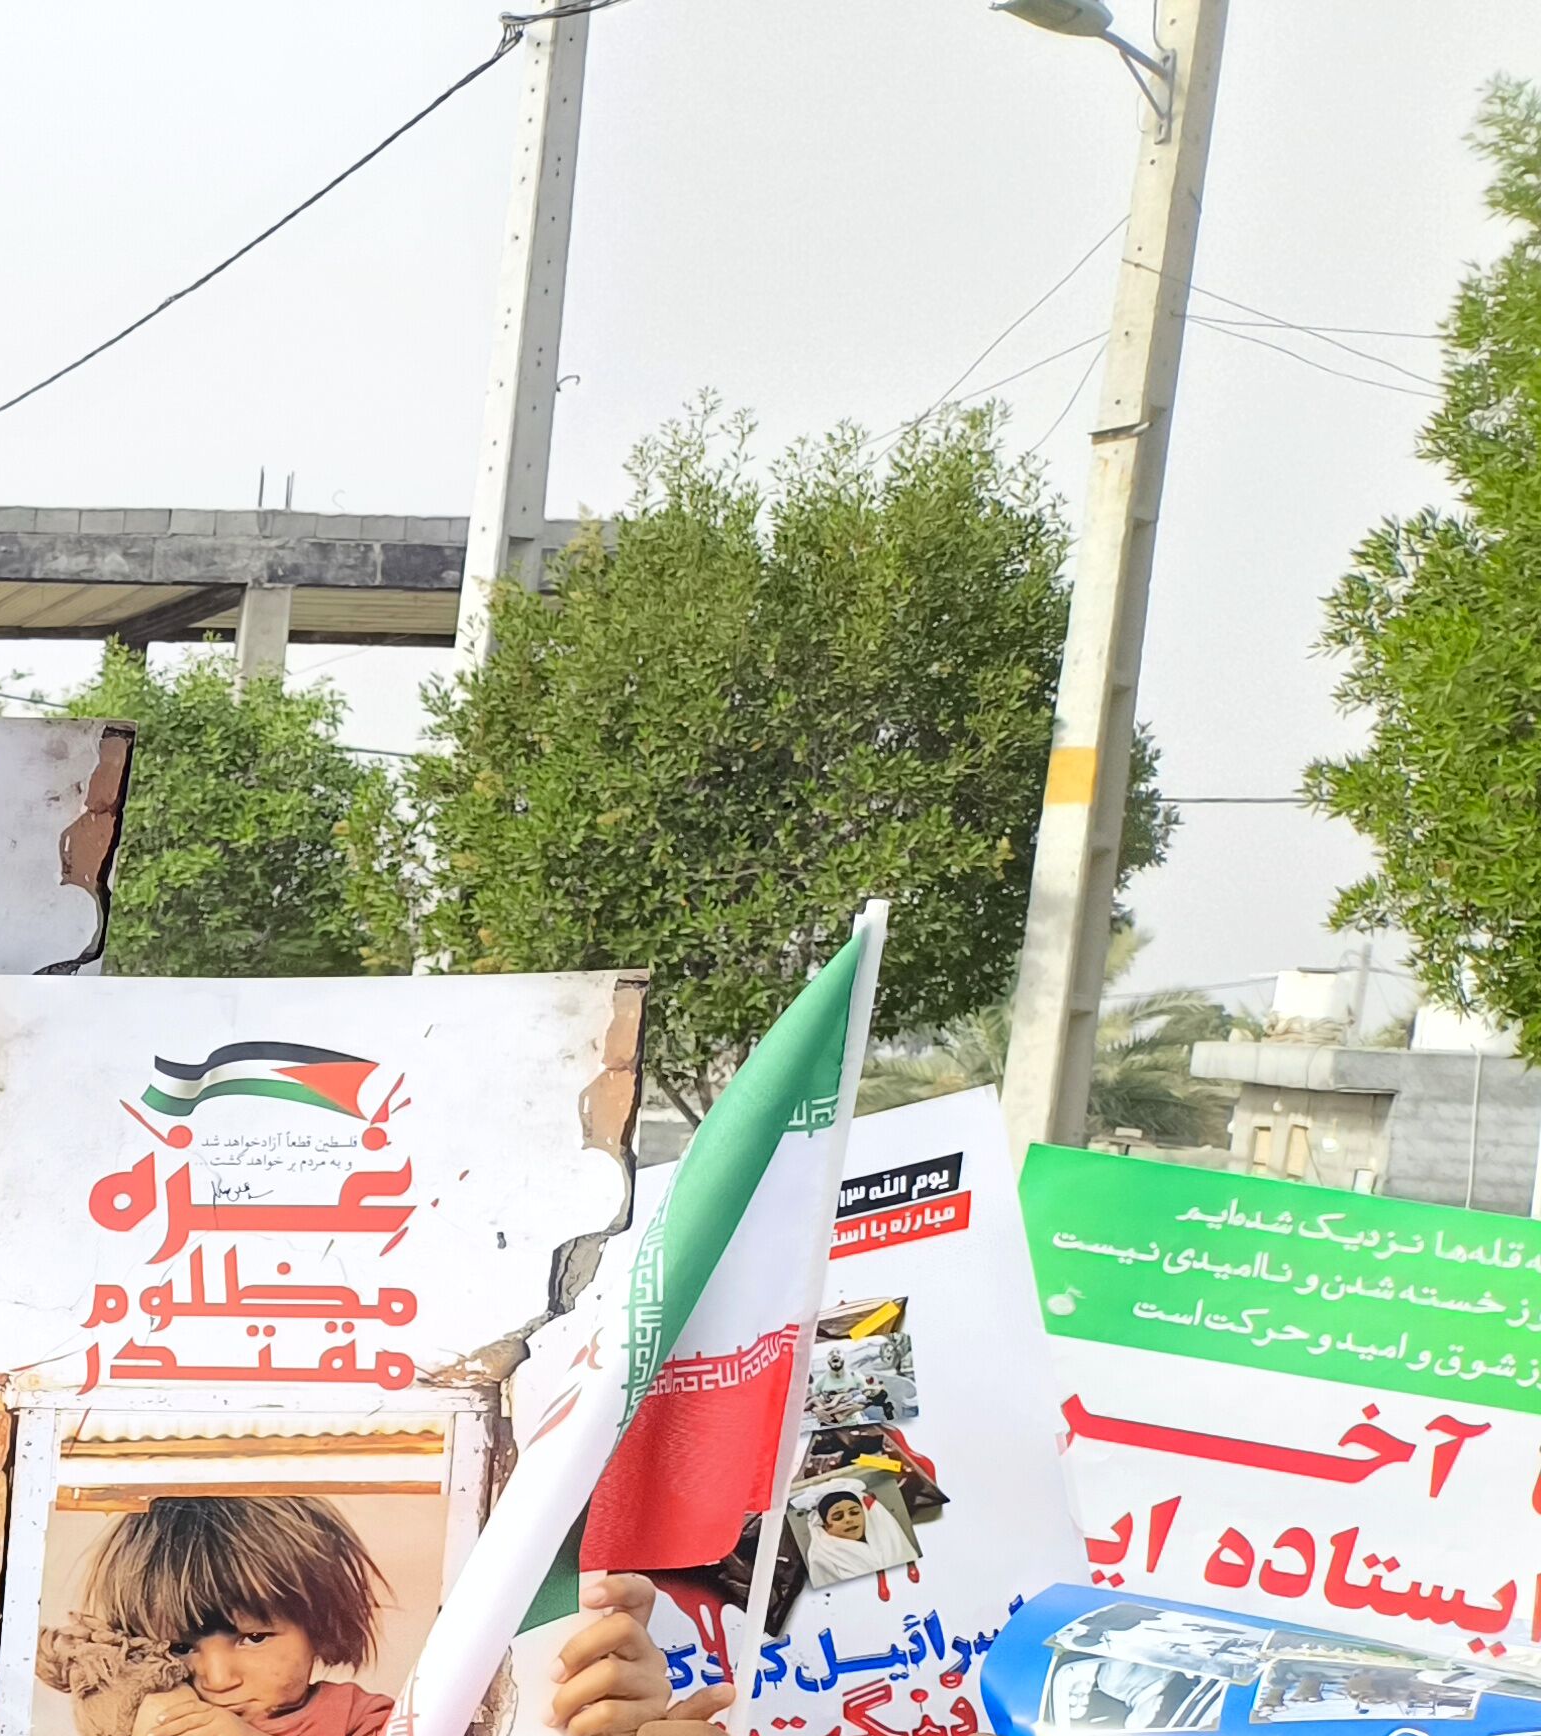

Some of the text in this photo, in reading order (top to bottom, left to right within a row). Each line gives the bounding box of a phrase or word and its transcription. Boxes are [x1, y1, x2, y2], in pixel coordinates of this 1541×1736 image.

[88, 1124, 419, 1266] غزه
[868, 1174, 907, 1201] الله
[911, 1169, 950, 1200] یوم
[870, 1205, 956, 1242] مبارزه با
[1297, 1212, 1426, 1260] نزدیک
[1051, 1229, 1161, 1264] نیست
[1162, 1247, 1293, 1284] ناامیدی
[80, 1244, 419, 1333] مظلوم
[1293, 1273, 1320, 1295] و
[1320, 1274, 1395, 1302] شدن
[1398, 1286, 1507, 1315] خسته
[1132, 1300, 1204, 1327] است
[1204, 1307, 1311, 1347] حرکت
[77, 1322, 417, 1395] مقتدر
[1306, 1333, 1332, 1355] و
[1336, 1332, 1409, 1361] امید
[1406, 1349, 1433, 1371] و
[1434, 1343, 1517, 1381] شوق
